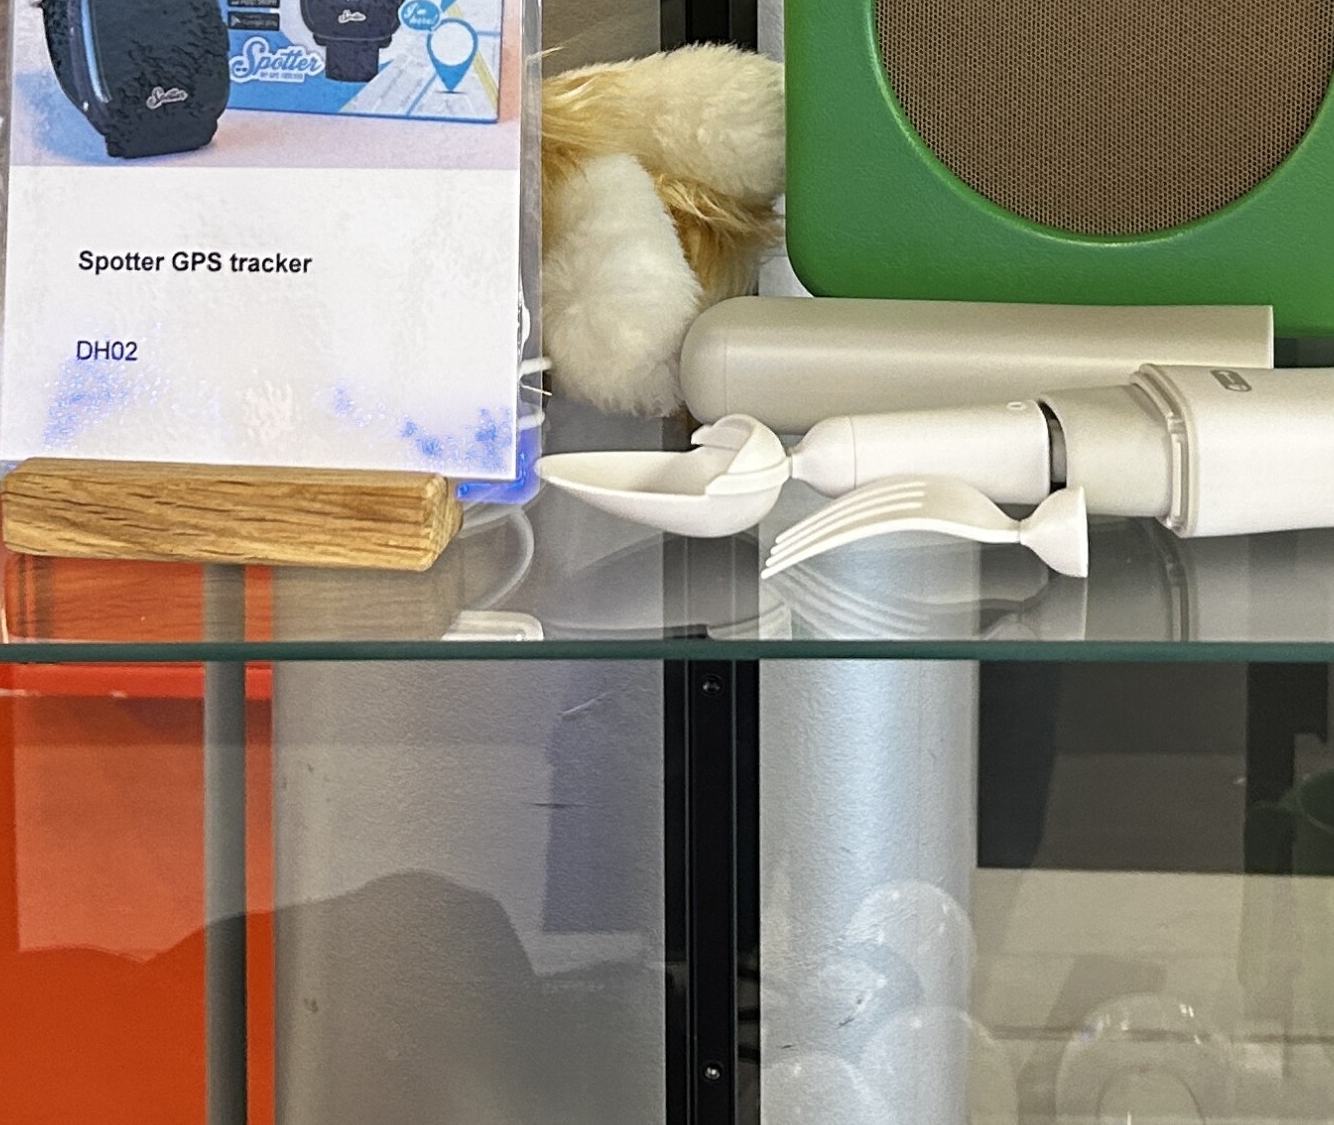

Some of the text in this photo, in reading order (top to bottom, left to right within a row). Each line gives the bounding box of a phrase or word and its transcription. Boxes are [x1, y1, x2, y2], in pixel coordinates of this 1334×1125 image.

[230, 38, 323, 79] Spotter
[78, 250, 313, 276] Spotter GPS tracker
[76, 340, 138, 362] DH02
